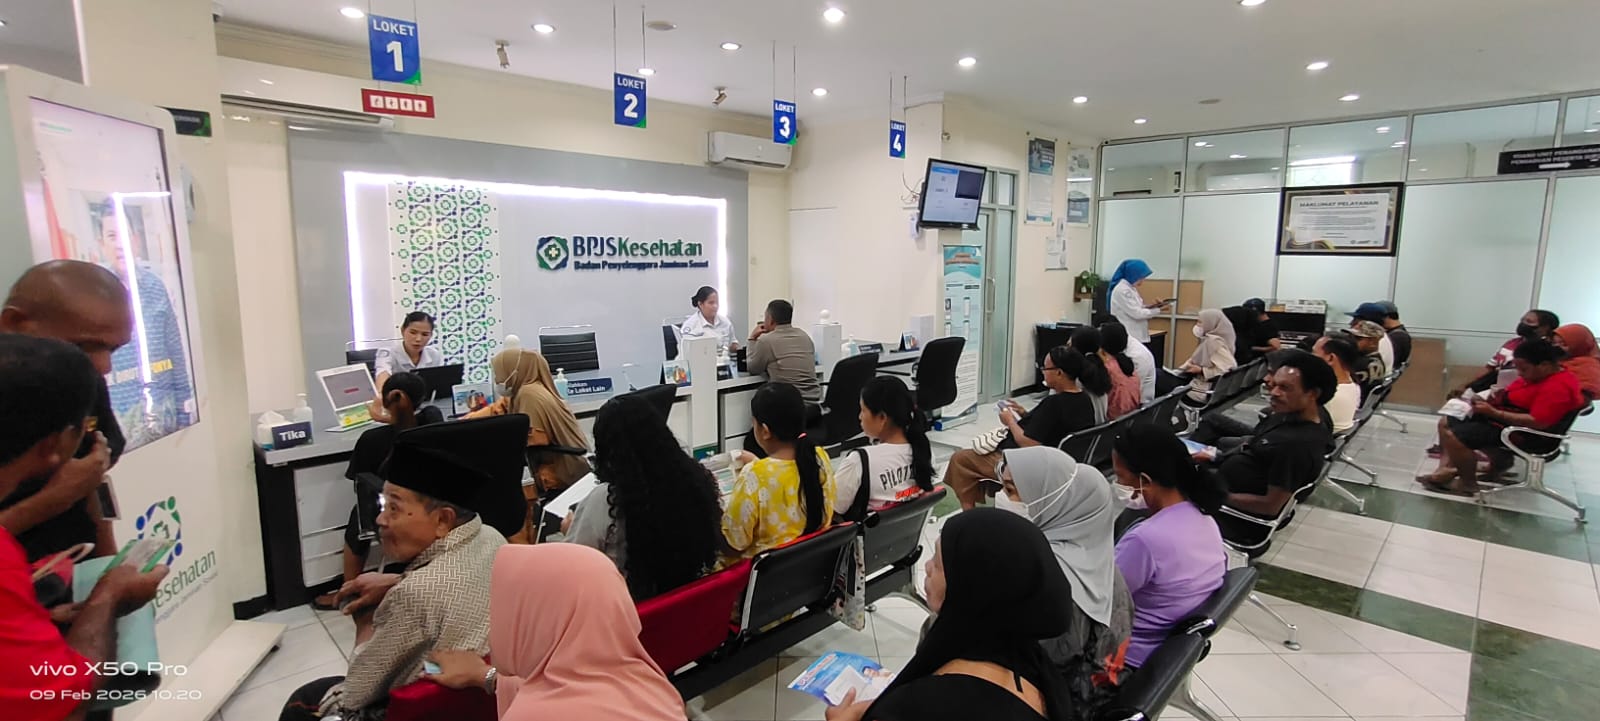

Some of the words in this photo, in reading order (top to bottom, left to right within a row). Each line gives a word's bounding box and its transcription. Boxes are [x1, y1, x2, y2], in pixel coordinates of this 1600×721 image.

[373, 19, 415, 37] LOKET
[386, 40, 404, 73] 1
[617, 76, 645, 90] LOKET
[623, 93, 638, 119] 2
[775, 102, 794, 113] LOKET
[779, 116, 791, 139] 3
[893, 133, 902, 152] 4
[279, 430, 306, 441] Tika
